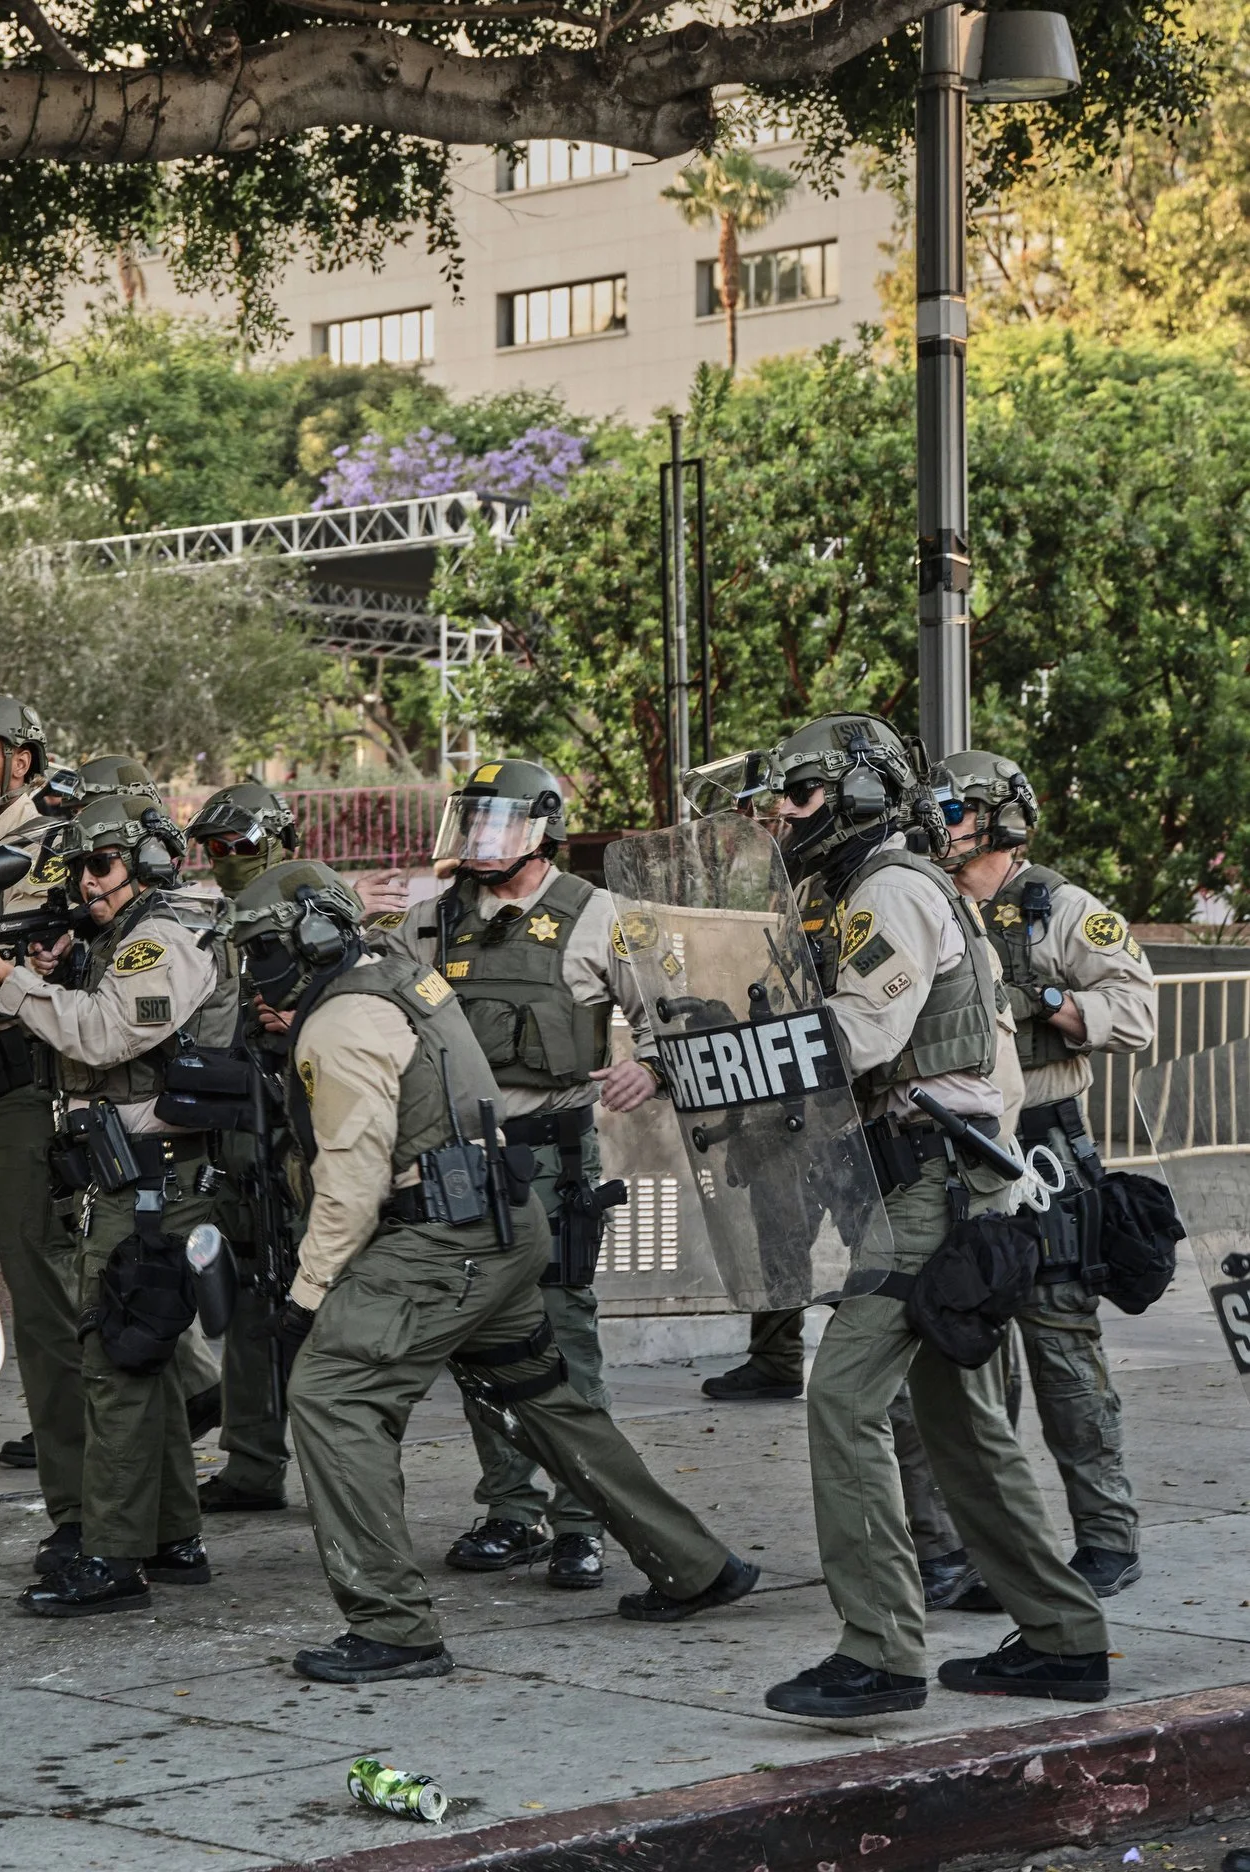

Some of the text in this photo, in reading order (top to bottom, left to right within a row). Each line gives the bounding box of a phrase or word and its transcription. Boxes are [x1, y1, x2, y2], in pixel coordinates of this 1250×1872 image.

[888, 983, 899, 994] B
[140, 1000, 168, 1019] SRT
[659, 1013, 828, 1108] SHERIFF
